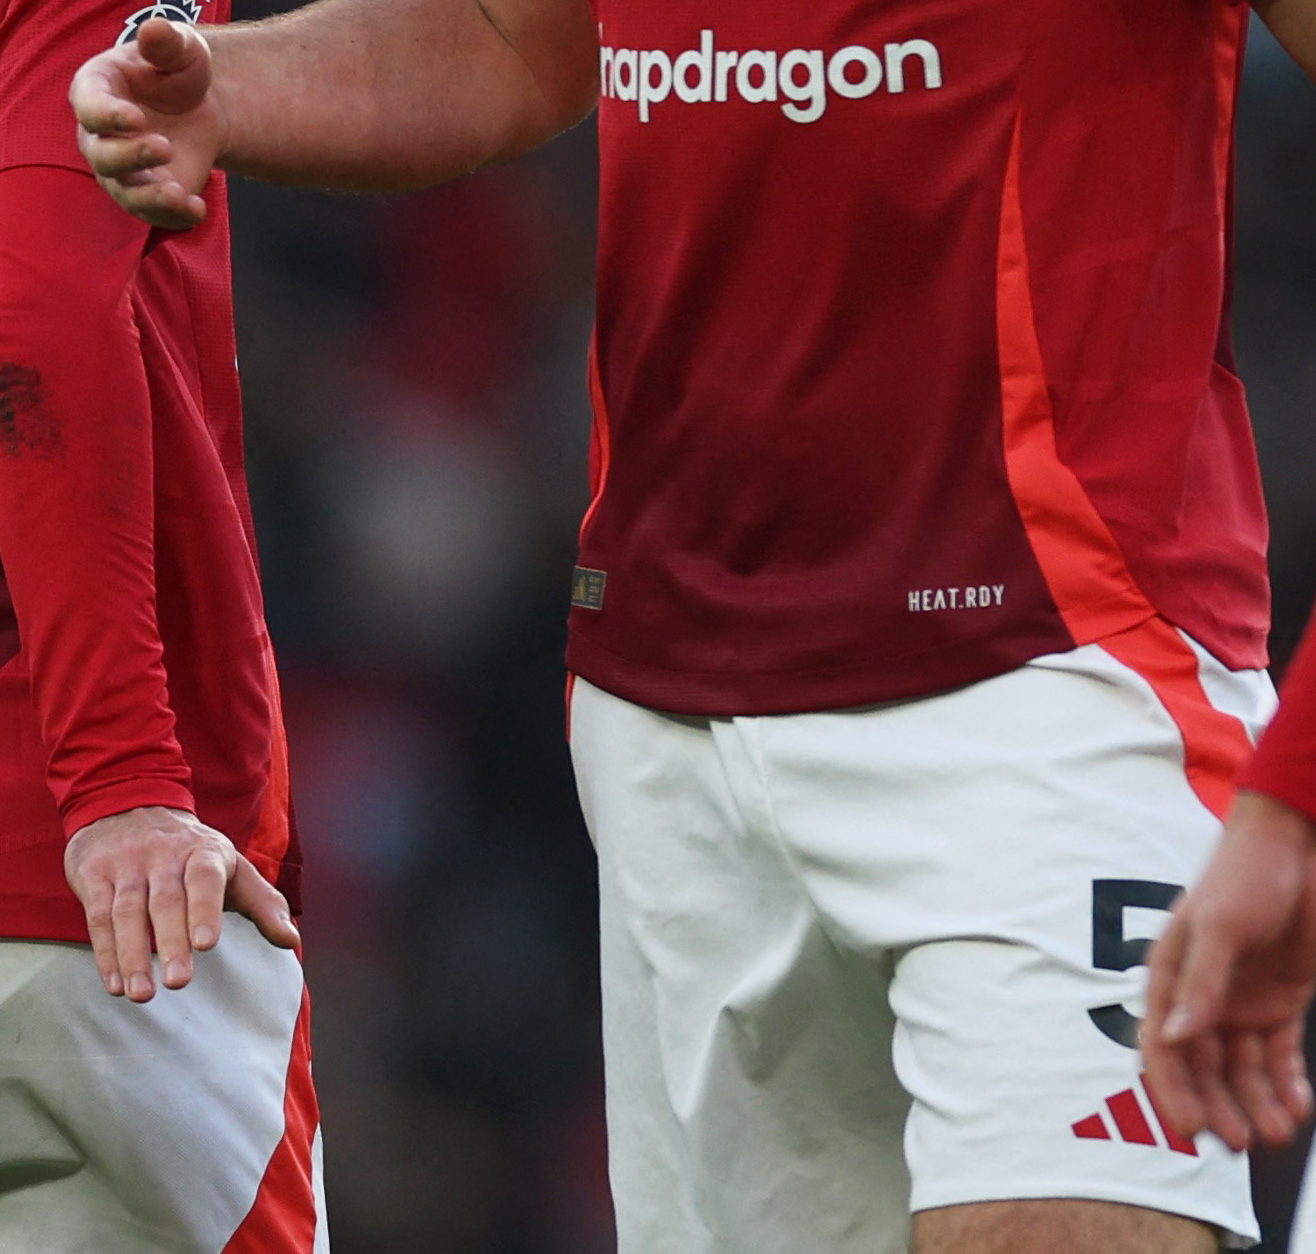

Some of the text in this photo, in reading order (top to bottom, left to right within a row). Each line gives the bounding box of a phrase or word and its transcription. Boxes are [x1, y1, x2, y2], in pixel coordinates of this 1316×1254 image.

[598, 22, 942, 123] napdragon
[908, 584, 1005, 612] HEAT.RDY
[1087, 879, 1186, 1050] 5
